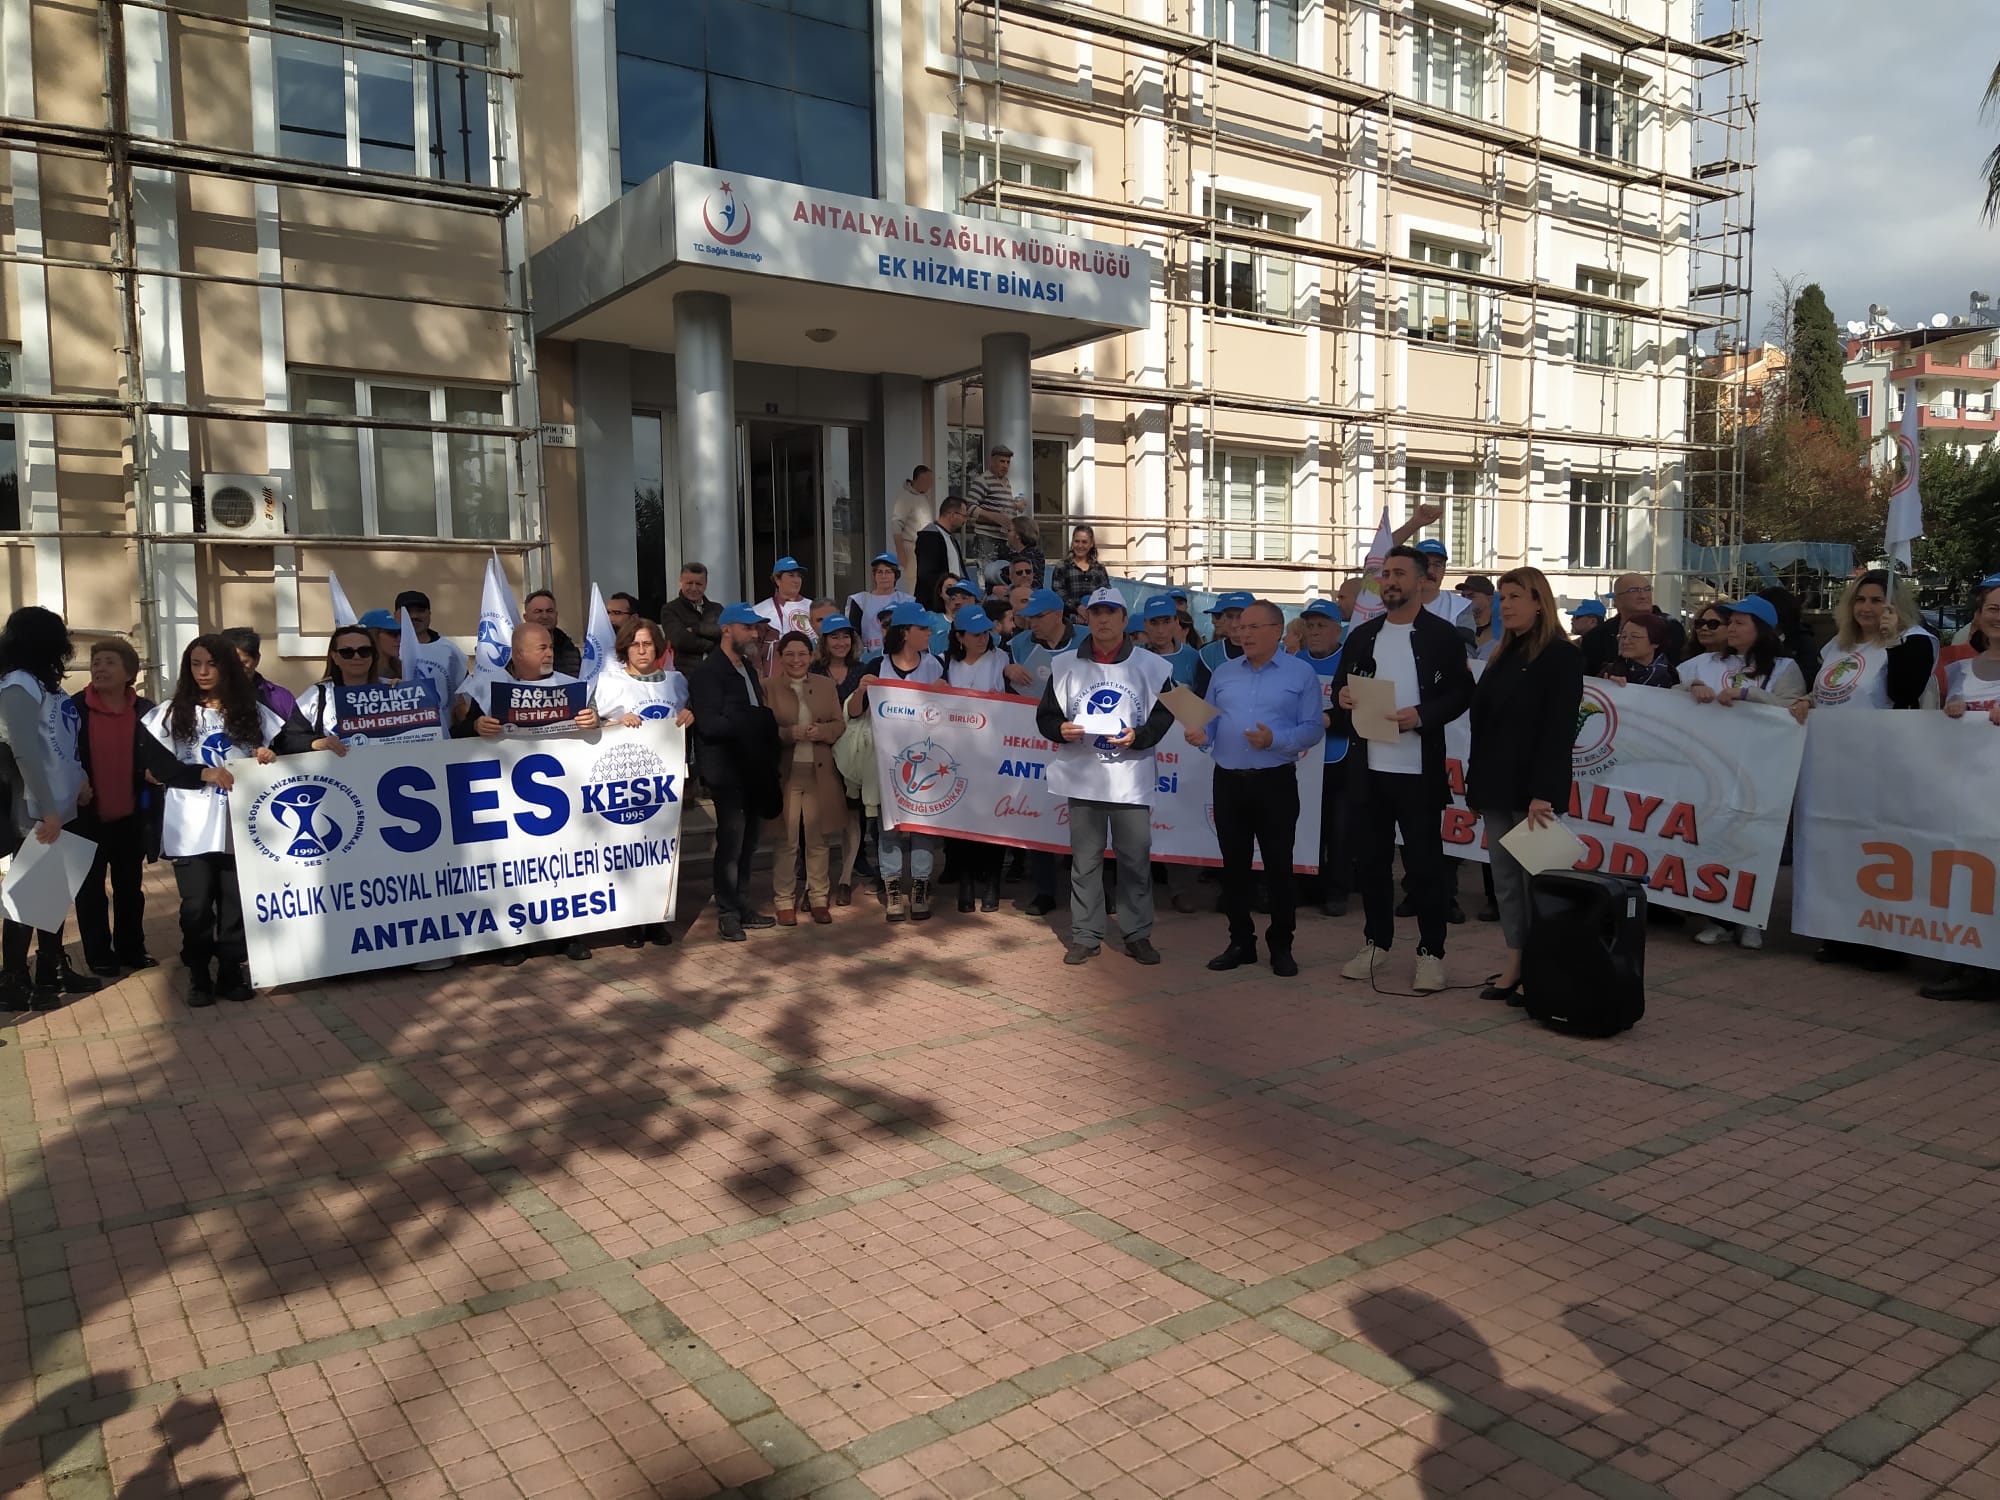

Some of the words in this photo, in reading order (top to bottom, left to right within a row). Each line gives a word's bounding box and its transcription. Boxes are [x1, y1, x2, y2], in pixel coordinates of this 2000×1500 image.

[793, 201, 899, 240] ANTALYA
[904, 215, 924, 244] İL
[930, 225, 1006, 258] SAĞLIK
[1012, 238, 1130, 279] MÜDÜRLÜĞÜ
[706, 245, 728, 256] Sağlık
[730, 249, 762, 262] Bakanlığı
[878, 254, 907, 279] EK
[913, 257, 991, 292] HİZMET
[997, 271, 1063, 303] BİNASI
[346, 686, 426, 704] SAĞLIKTA
[512, 688, 566, 699] SAĞLIK
[353, 698, 420, 715] TİCARET
[510, 698, 568, 709] BAKANI
[886, 705, 915, 716] HEKİM
[342, 718, 375, 731] ÖLÜM
[378, 710, 436, 726] DEMEKTİR
[515, 708, 563, 721] İSTİFA!
[949, 713, 978, 724] BİRLİĞİ
[1003, 735, 1048, 750] HEKİM
[1589, 757, 1618, 776] ODASI
[270, 775, 310, 791] HİZMET
[313, 775, 364, 808] EMEKÇİLERİ
[376, 753, 571, 853] SES
[581, 774, 678, 814] KESK
[929, 780, 965, 812] SENDİKASI
[248, 791, 271, 822] SOSYAL
[620, 810, 645, 823] 1995
[248, 823, 256, 835] VE
[341, 809, 365, 853] SENDİKASI
[252, 837, 280, 862] SAĞLIK
[293, 847, 320, 856] 1996
[256, 881, 327, 923] SAĞLIK
[330, 882, 356, 912] VE
[360, 872, 432, 908] SOSYAL
[435, 862, 497, 897] HİZMET
[503, 842, 599, 888] EMEKÇİLERİ
[351, 908, 498, 954] ANTALYA
[507, 882, 617, 935] ŞUBESİ
[1857, 909, 1983, 949] ANTALYA
